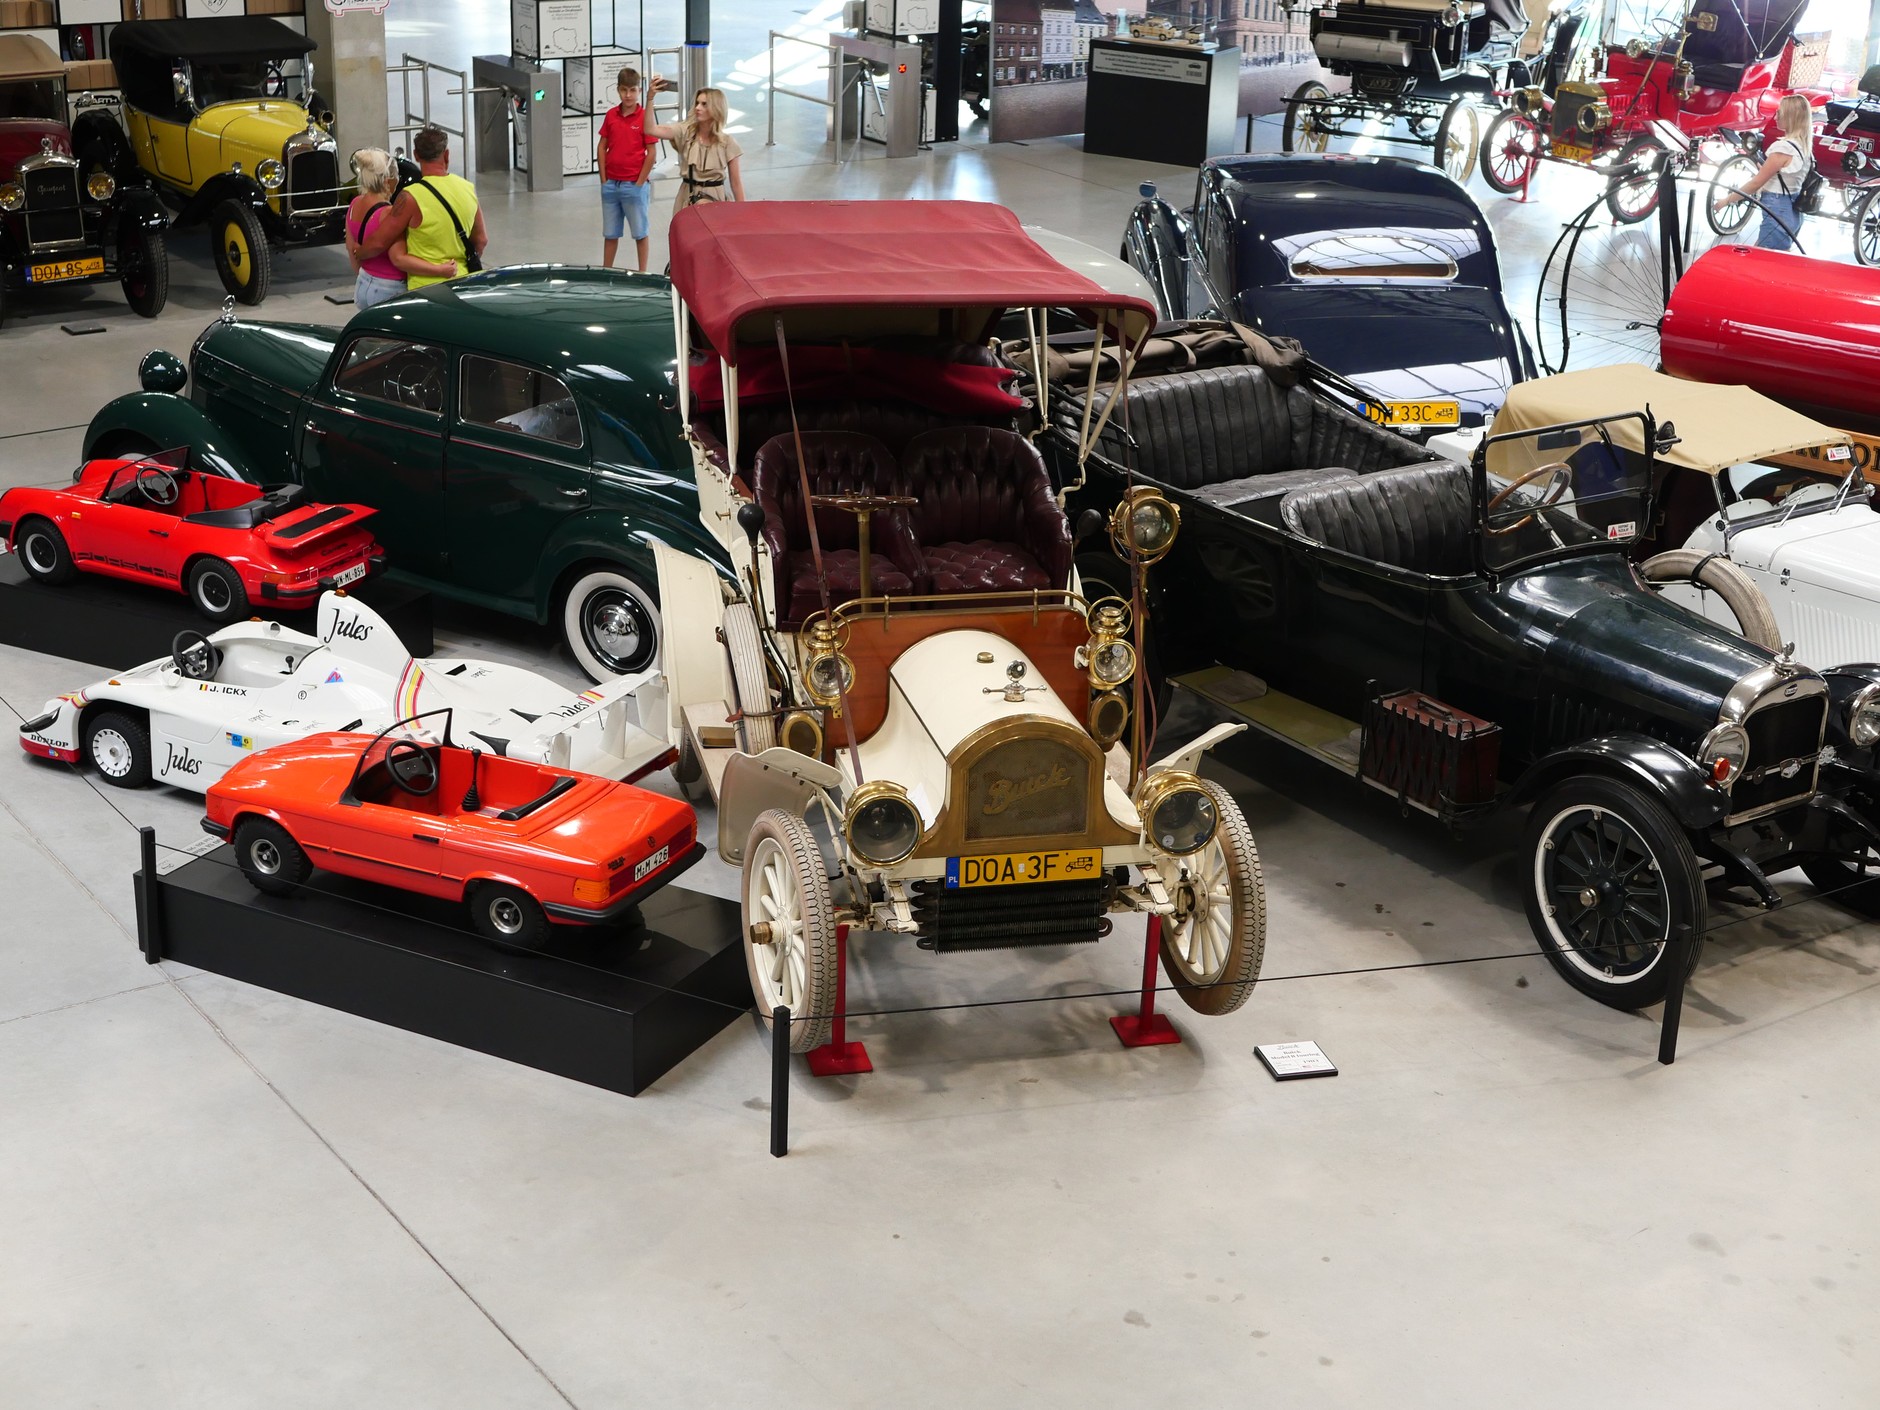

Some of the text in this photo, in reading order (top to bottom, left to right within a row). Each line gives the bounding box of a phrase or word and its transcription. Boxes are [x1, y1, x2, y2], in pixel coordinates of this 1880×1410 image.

[37, 184, 66, 195] Peugeot
[34, 265, 62, 281] DOA
[66, 262, 83, 276] 8S
[1401, 405, 1432, 421] 33C
[72, 552, 179, 580] PORSCHE
[324, 608, 373, 643] Jules
[222, 687, 247, 697] ICKX
[30, 734, 69, 748] DUNLOP
[161, 742, 202, 776] Jules
[983, 763, 1072, 816] Buick
[654, 848, 668, 866] 426
[965, 857, 1016, 884] DOA
[1027, 853, 1060, 880] 3F
